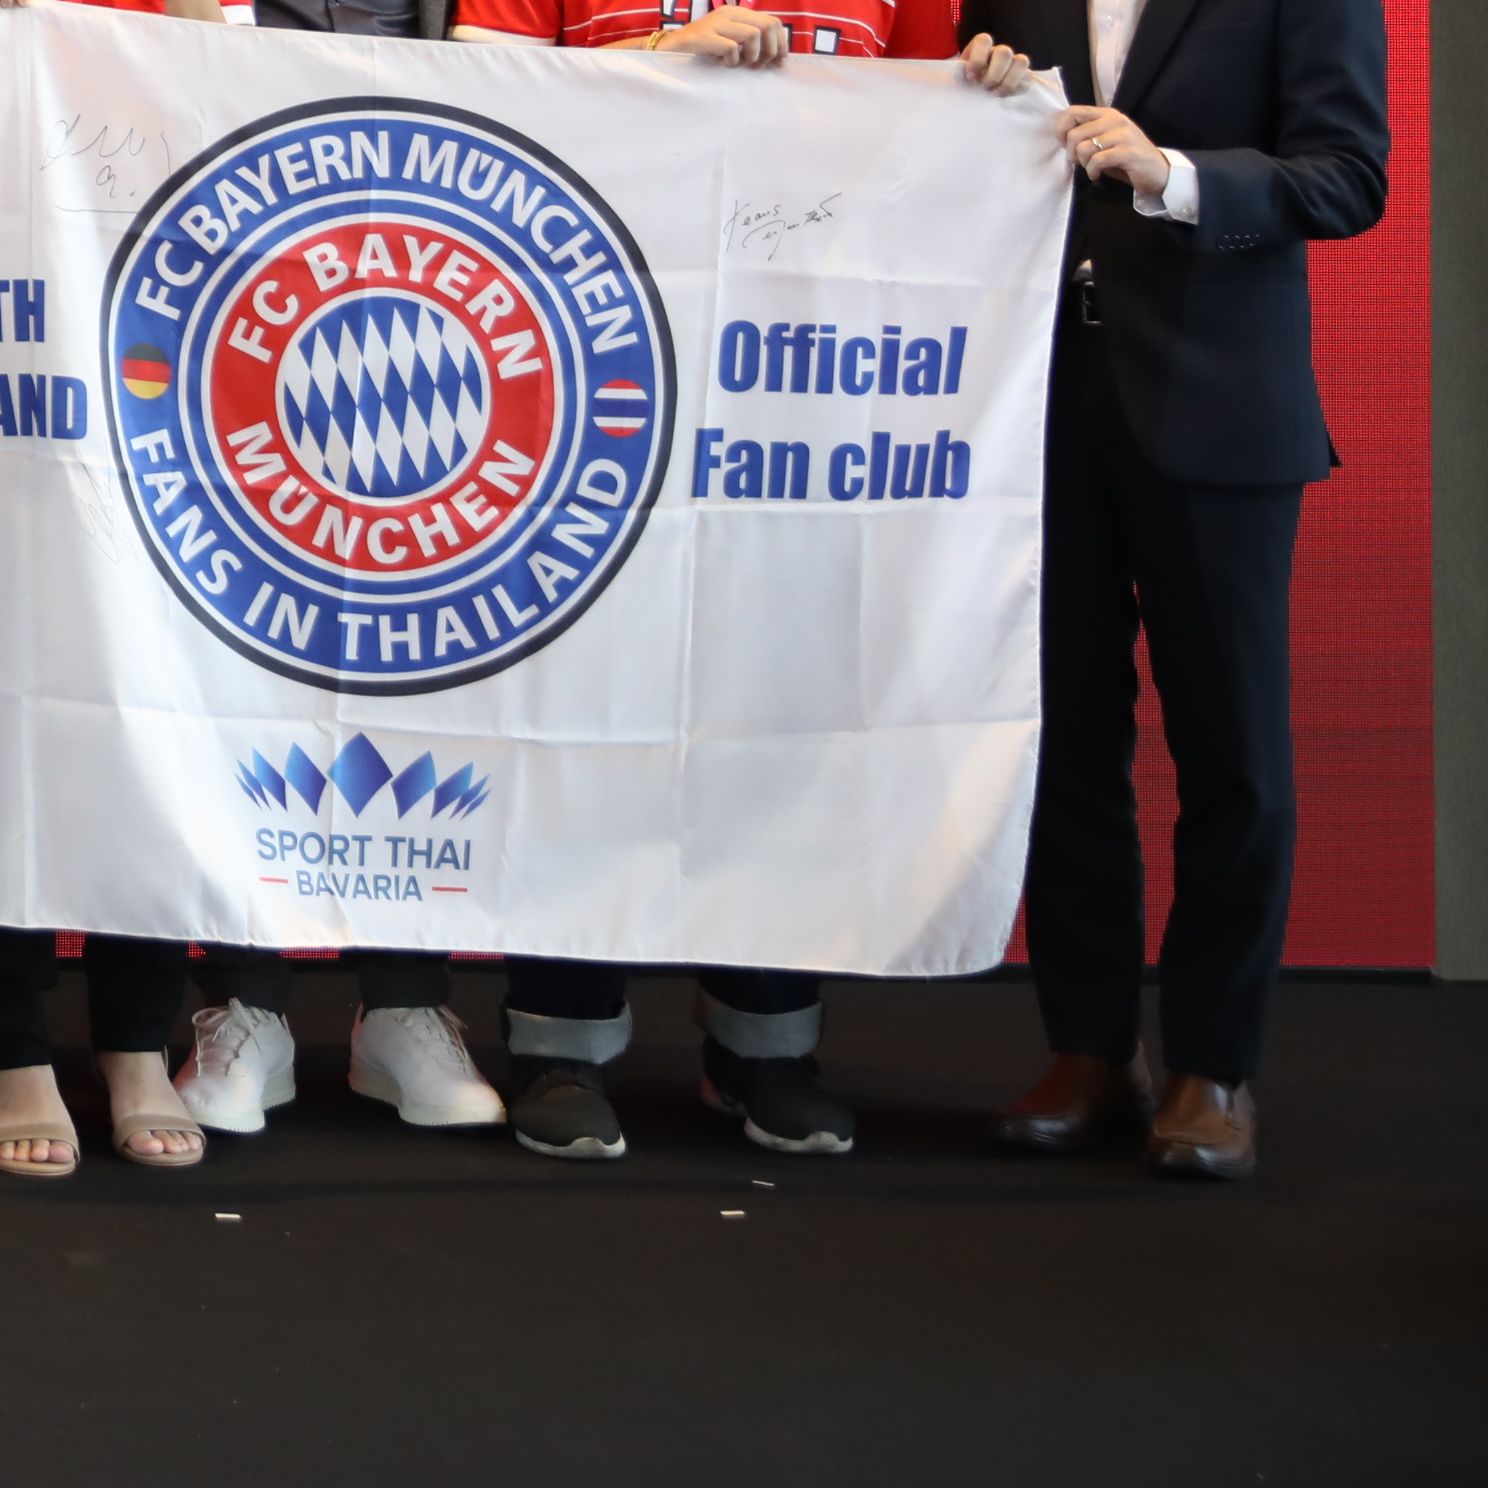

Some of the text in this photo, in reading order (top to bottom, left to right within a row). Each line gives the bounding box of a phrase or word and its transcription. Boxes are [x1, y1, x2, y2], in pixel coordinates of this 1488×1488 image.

[135, 242, 204, 321] FC
[177, 130, 390, 254] BAYERN
[402, 133, 639, 354] MÜNCHEN
[227, 232, 543, 381] FC BAYERN
[717, 320, 969, 396] Official
[225, 420, 537, 563] MÜNCHEN
[690, 428, 972, 501] Fan club
[129, 428, 243, 595] FANS
[243, 582, 320, 652] IN
[337, 457, 629, 662] THAILAND
[256, 827, 471, 871] SPORT THAI
[295, 870, 424, 902] BAVARIA
